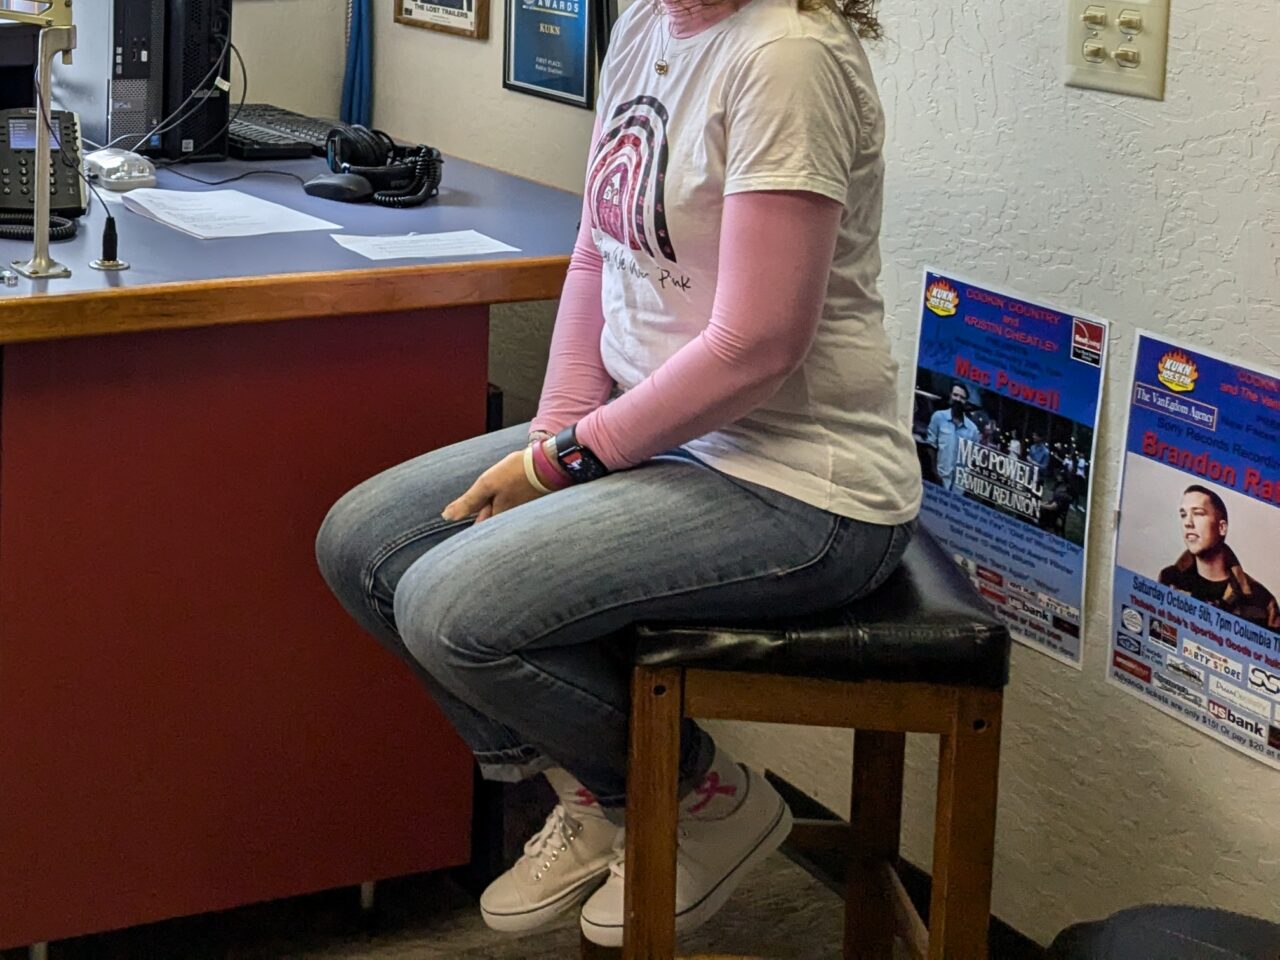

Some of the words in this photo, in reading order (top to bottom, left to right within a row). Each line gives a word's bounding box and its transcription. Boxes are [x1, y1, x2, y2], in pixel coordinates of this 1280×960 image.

[426, 5, 440, 13] LOST
[442, 8, 468, 18] TRAILERS
[539, 23, 560, 35] KUKN
[932, 288, 954, 301] KUKN
[964, 315, 1002, 335] KRISTIN
[1009, 301, 1061, 325] COUNTRY
[955, 355, 991, 385] Mac
[996, 370, 1061, 412] Powell
[1164, 358, 1193, 375] KUKN
[1180, 375, 1192, 386] FM
[1136, 387, 1151, 402] The
[1189, 406, 1214, 426] Agency
[1220, 382, 1238, 395] and
[1240, 389, 1258, 402] The
[1157, 416, 1184, 436] Sony
[1185, 427, 1229, 452] Records
[956, 437, 988, 472] MAC
[988, 449, 1043, 498] POWELL
[1142, 431, 1237, 487] Brandon
[955, 466, 992, 499] FAMILY
[992, 486, 1042, 519] REUNION
[1129, 594, 1156, 614] Tickets
[1190, 623, 1224, 646] Sporting
[1225, 637, 1252, 657] Goods
[1253, 649, 1263, 660] or
[1132, 575, 1165, 605] Saturday
[1166, 592, 1197, 616] October
[1198, 604, 1213, 627] 5th,
[1215, 611, 1232, 635] 7pm
[1233, 620, 1270, 650] Columbia
[1183, 646, 1211, 665] PARTY
[1213, 659, 1241, 680] STORE
[1113, 671, 1145, 691] Advance
[1145, 685, 1169, 705] tickets
[1170, 701, 1182, 711] are
[1184, 707, 1200, 721] only
[1220, 725, 1230, 736] Or
[1232, 731, 1247, 744] pay
[1249, 738, 1264, 752] $20
